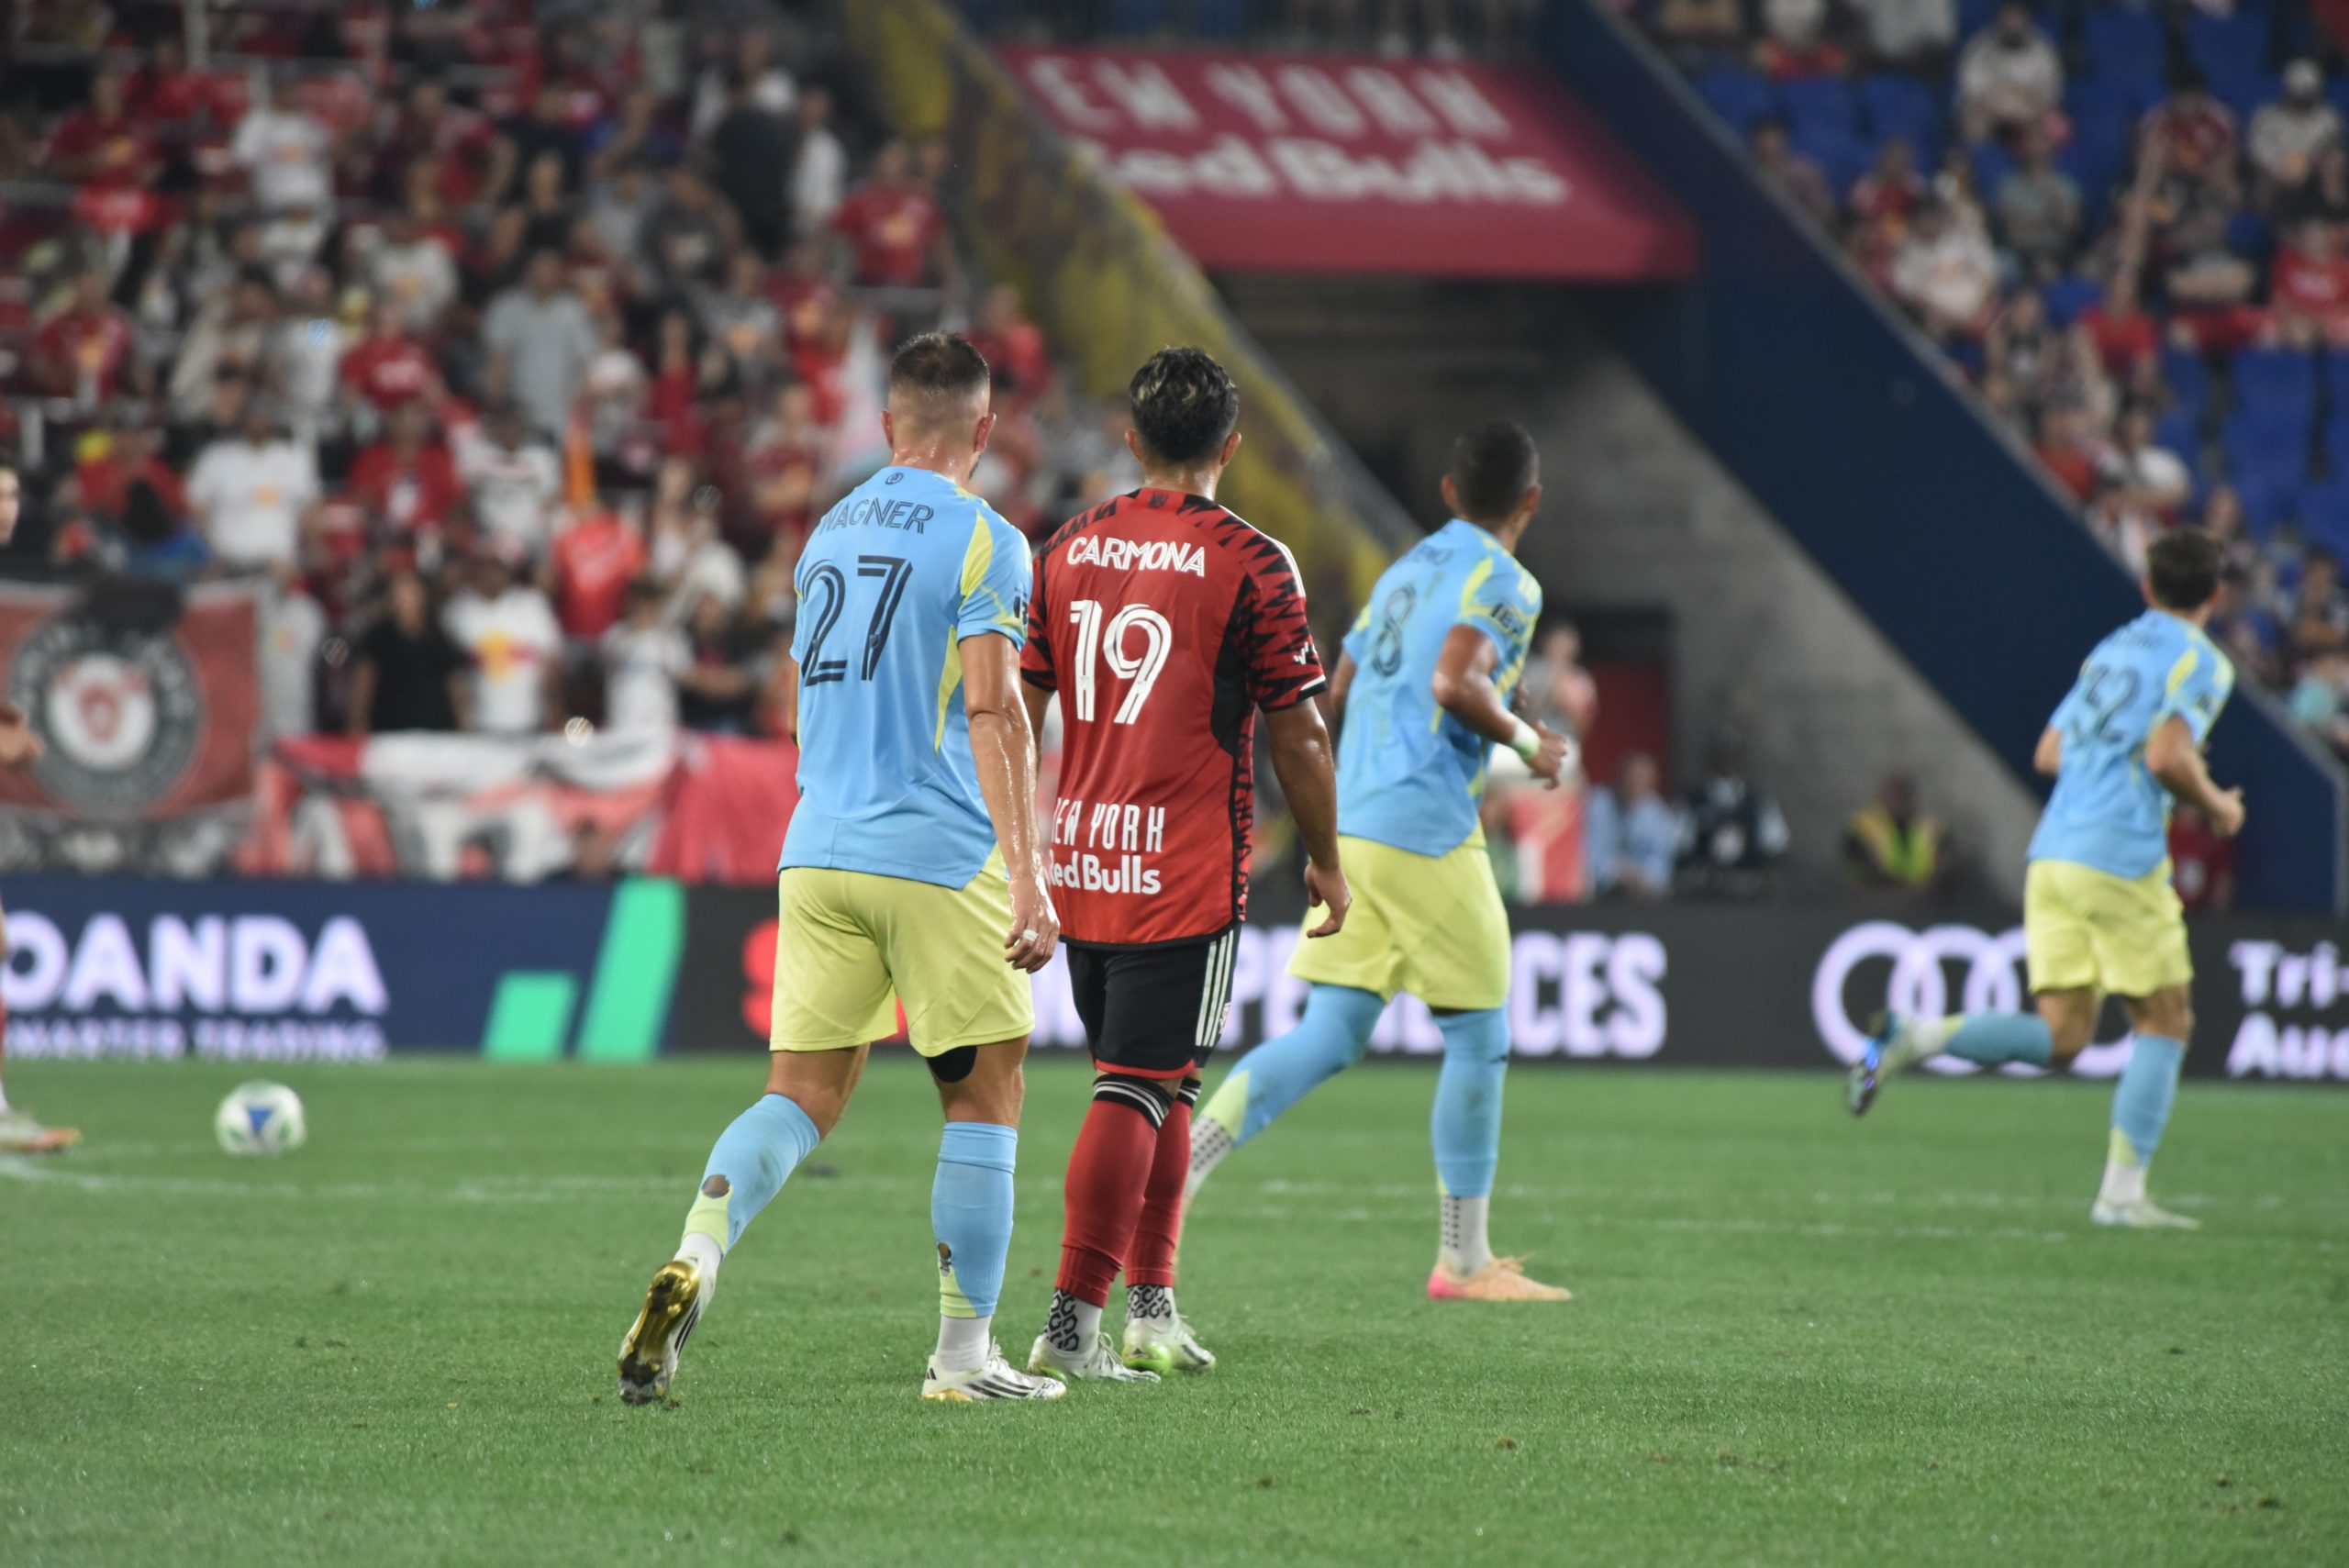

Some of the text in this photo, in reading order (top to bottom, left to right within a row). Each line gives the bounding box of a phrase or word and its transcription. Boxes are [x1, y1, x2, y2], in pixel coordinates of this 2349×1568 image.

[1268, 134, 1568, 205] Bulls
[818, 496, 935, 535] WAGNER
[1067, 535, 1205, 578] CARMONA
[800, 552, 913, 687] 27
[1372, 582, 1417, 678] 8
[1070, 599, 1172, 724] 19
[1088, 802, 1165, 853] YORK
[0, 911, 389, 1013] OANDA
